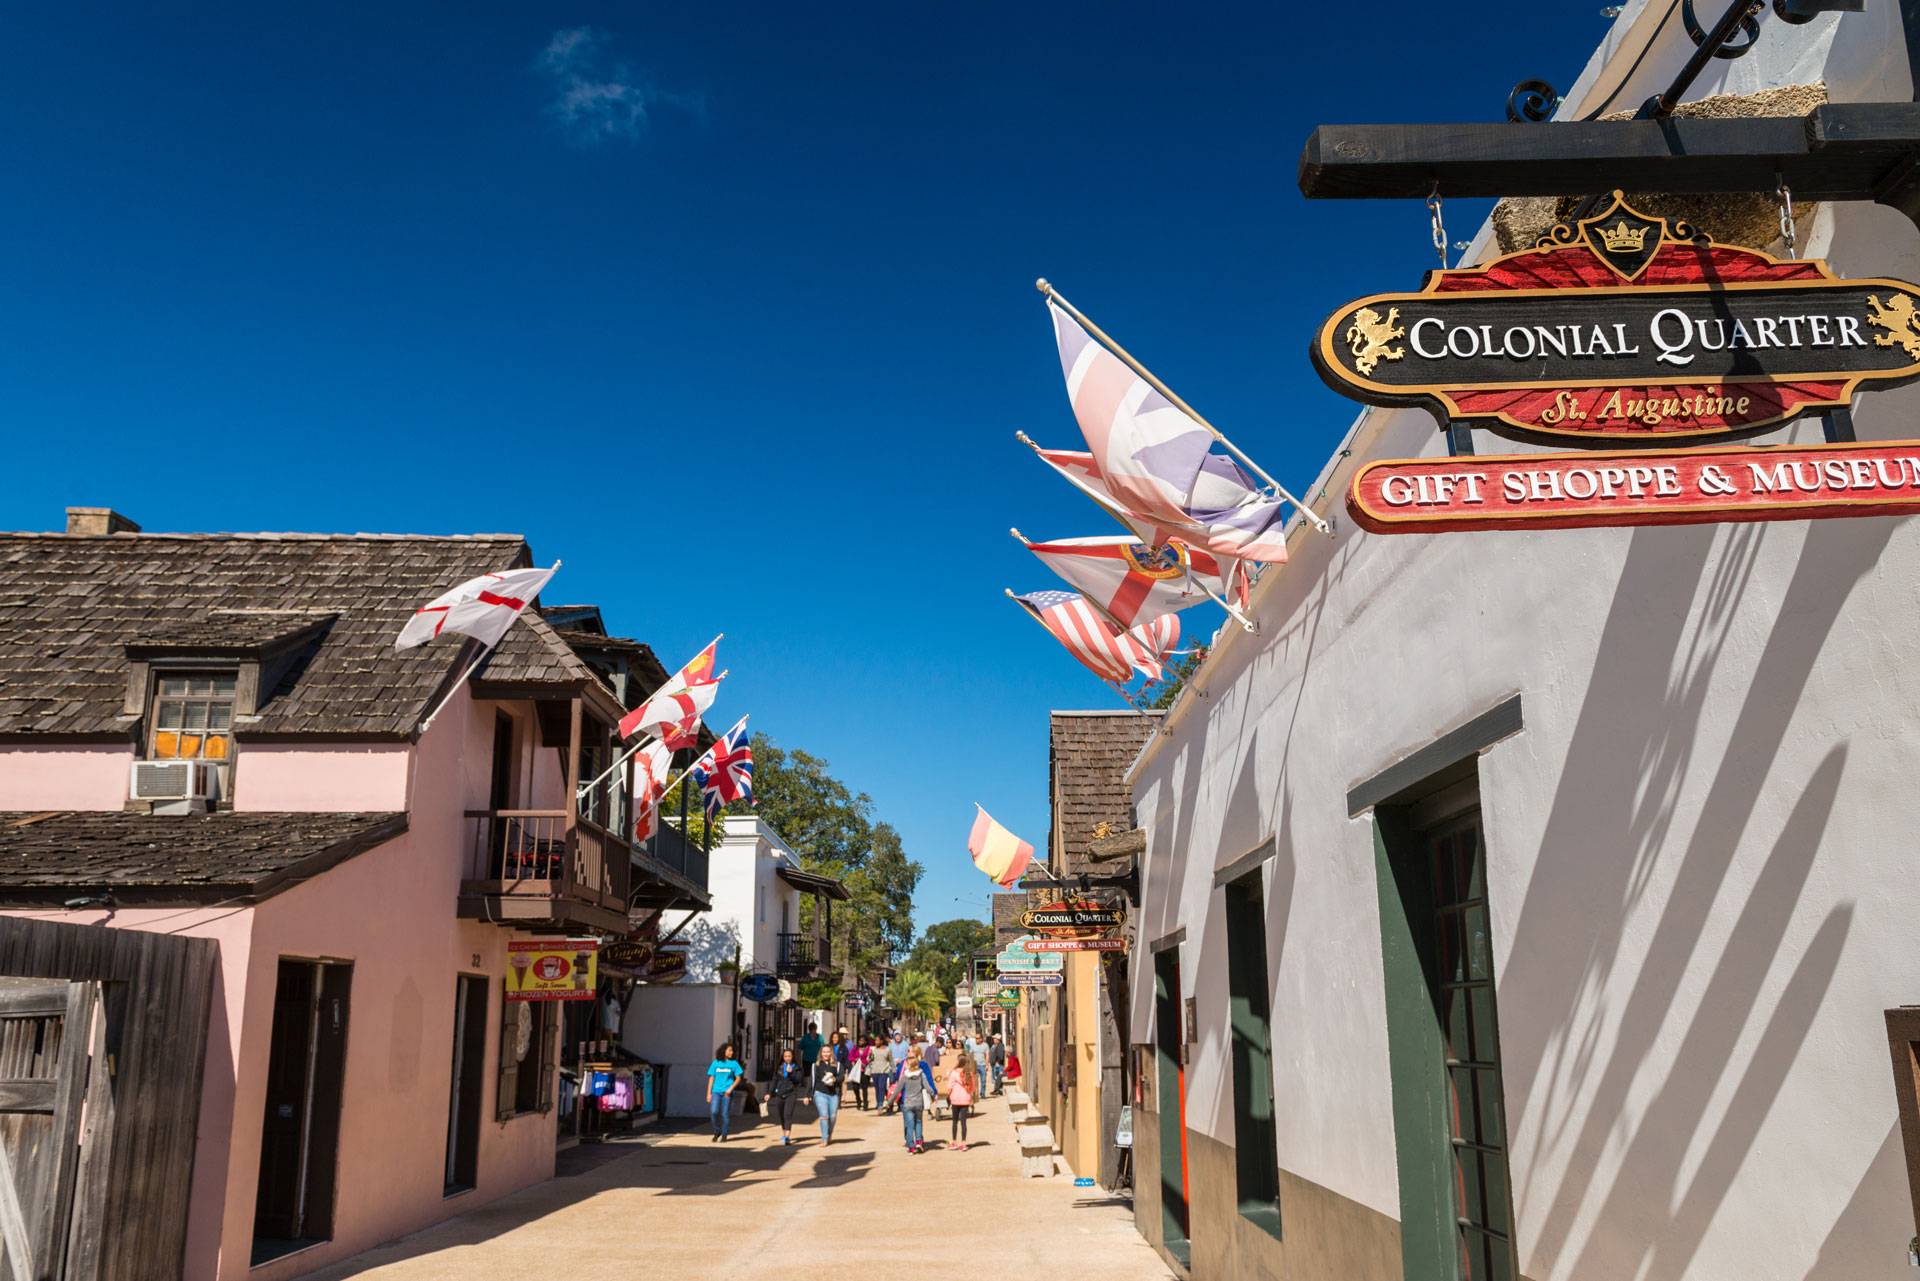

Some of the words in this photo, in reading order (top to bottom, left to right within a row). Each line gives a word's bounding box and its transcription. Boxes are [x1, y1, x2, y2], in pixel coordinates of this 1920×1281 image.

[1409, 317, 1639, 359] COLONIAL
[1650, 308, 1868, 365] QUARTER
[1541, 391, 1587, 424] St.
[1602, 386, 1750, 425] Augustine
[1381, 472, 1487, 506] GIFT
[1504, 466, 1683, 502] SHOPPE
[1697, 464, 1738, 496] &
[1034, 913, 1073, 923] COLONIAL
[1075, 912, 1112, 924] QUARTER
[1048, 941, 1078, 949] SHOPPE
[513, 990, 549, 998] FROZEN
